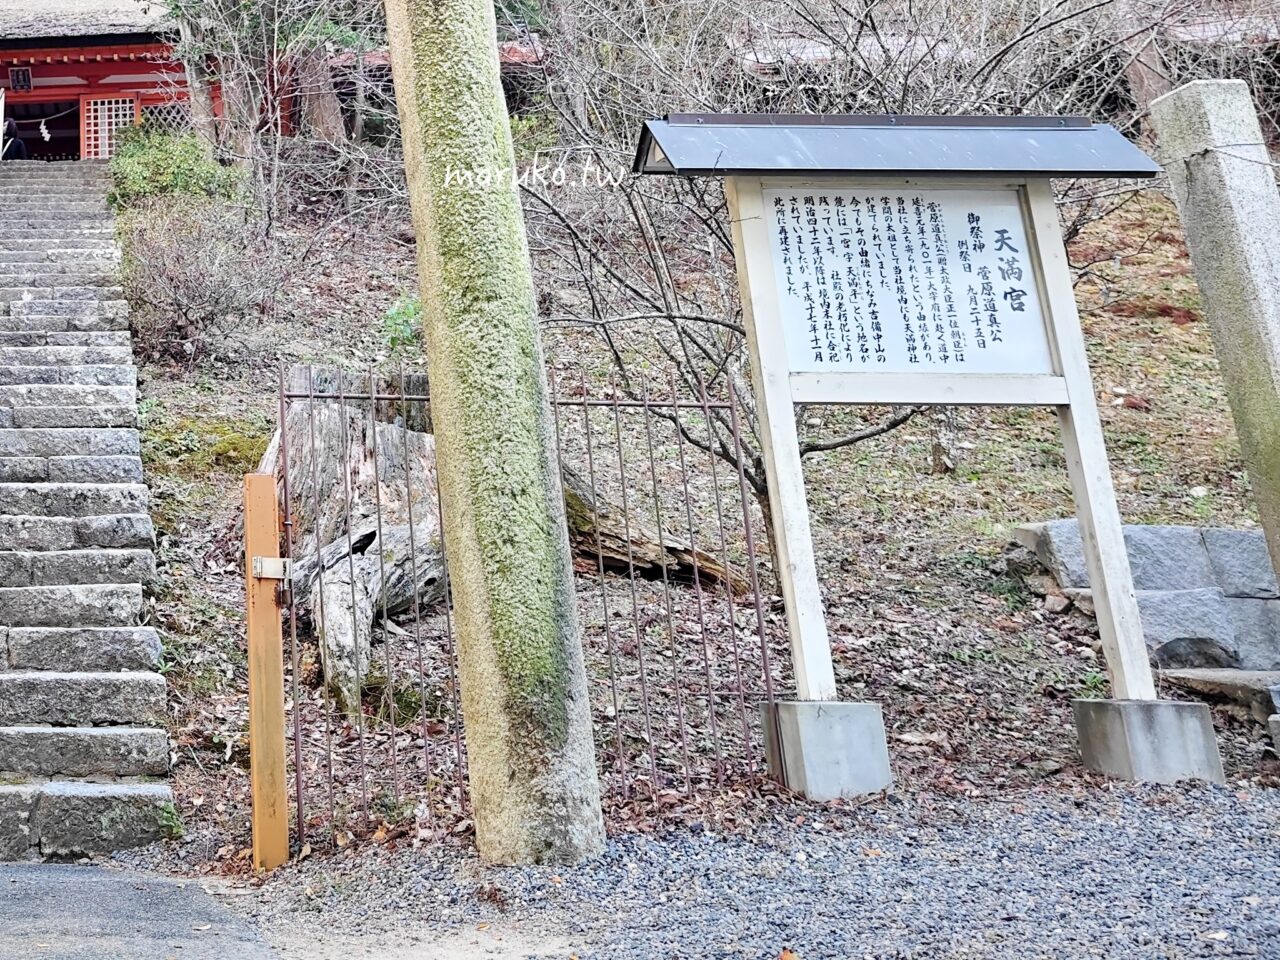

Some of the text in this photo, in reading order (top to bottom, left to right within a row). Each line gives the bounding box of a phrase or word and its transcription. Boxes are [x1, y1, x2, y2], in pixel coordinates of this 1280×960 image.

[957, 239, 987, 349] 例祭日 九月二十五日
[966, 211, 1003, 343] 御祭神 菅原道真公
[993, 228, 1028, 313] 天満宮
